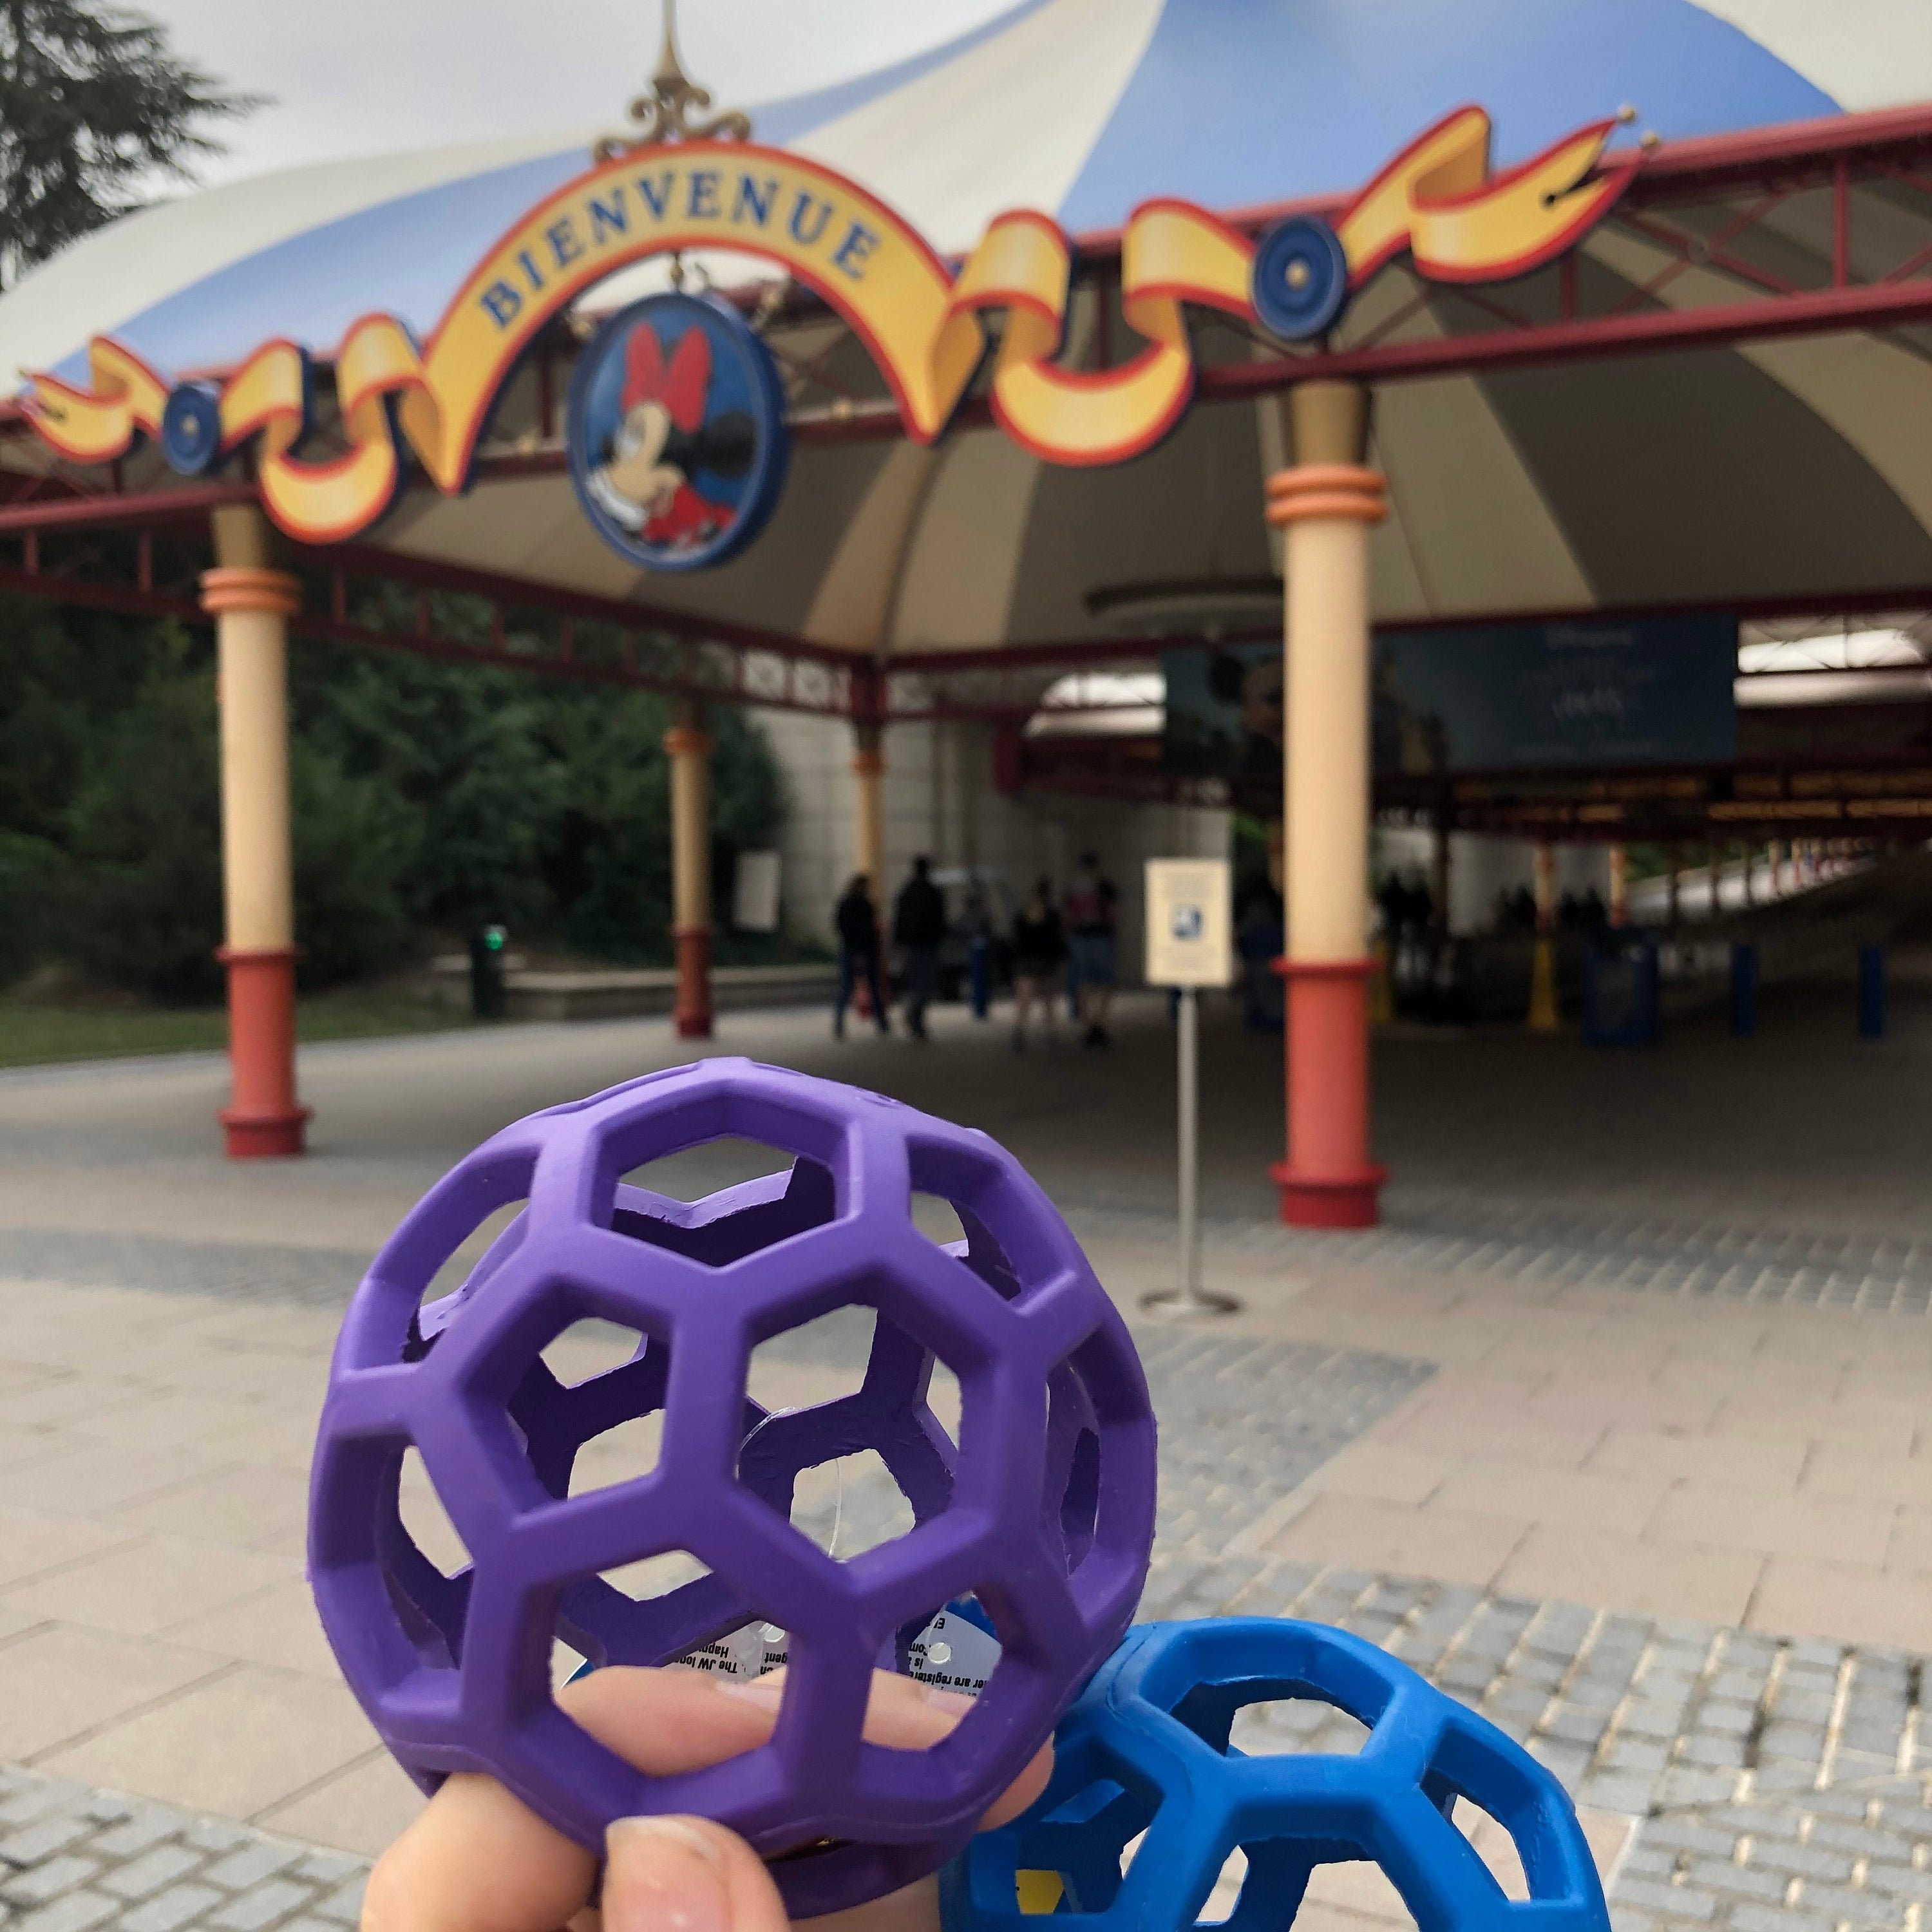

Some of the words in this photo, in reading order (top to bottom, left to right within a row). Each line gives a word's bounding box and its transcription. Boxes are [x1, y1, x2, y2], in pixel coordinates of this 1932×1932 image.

[479, 170, 882, 331] BIENVENUE
[697, 1657, 716, 1671] JW
[719, 1660, 738, 1674] The
[954, 1676, 971, 1687] are
